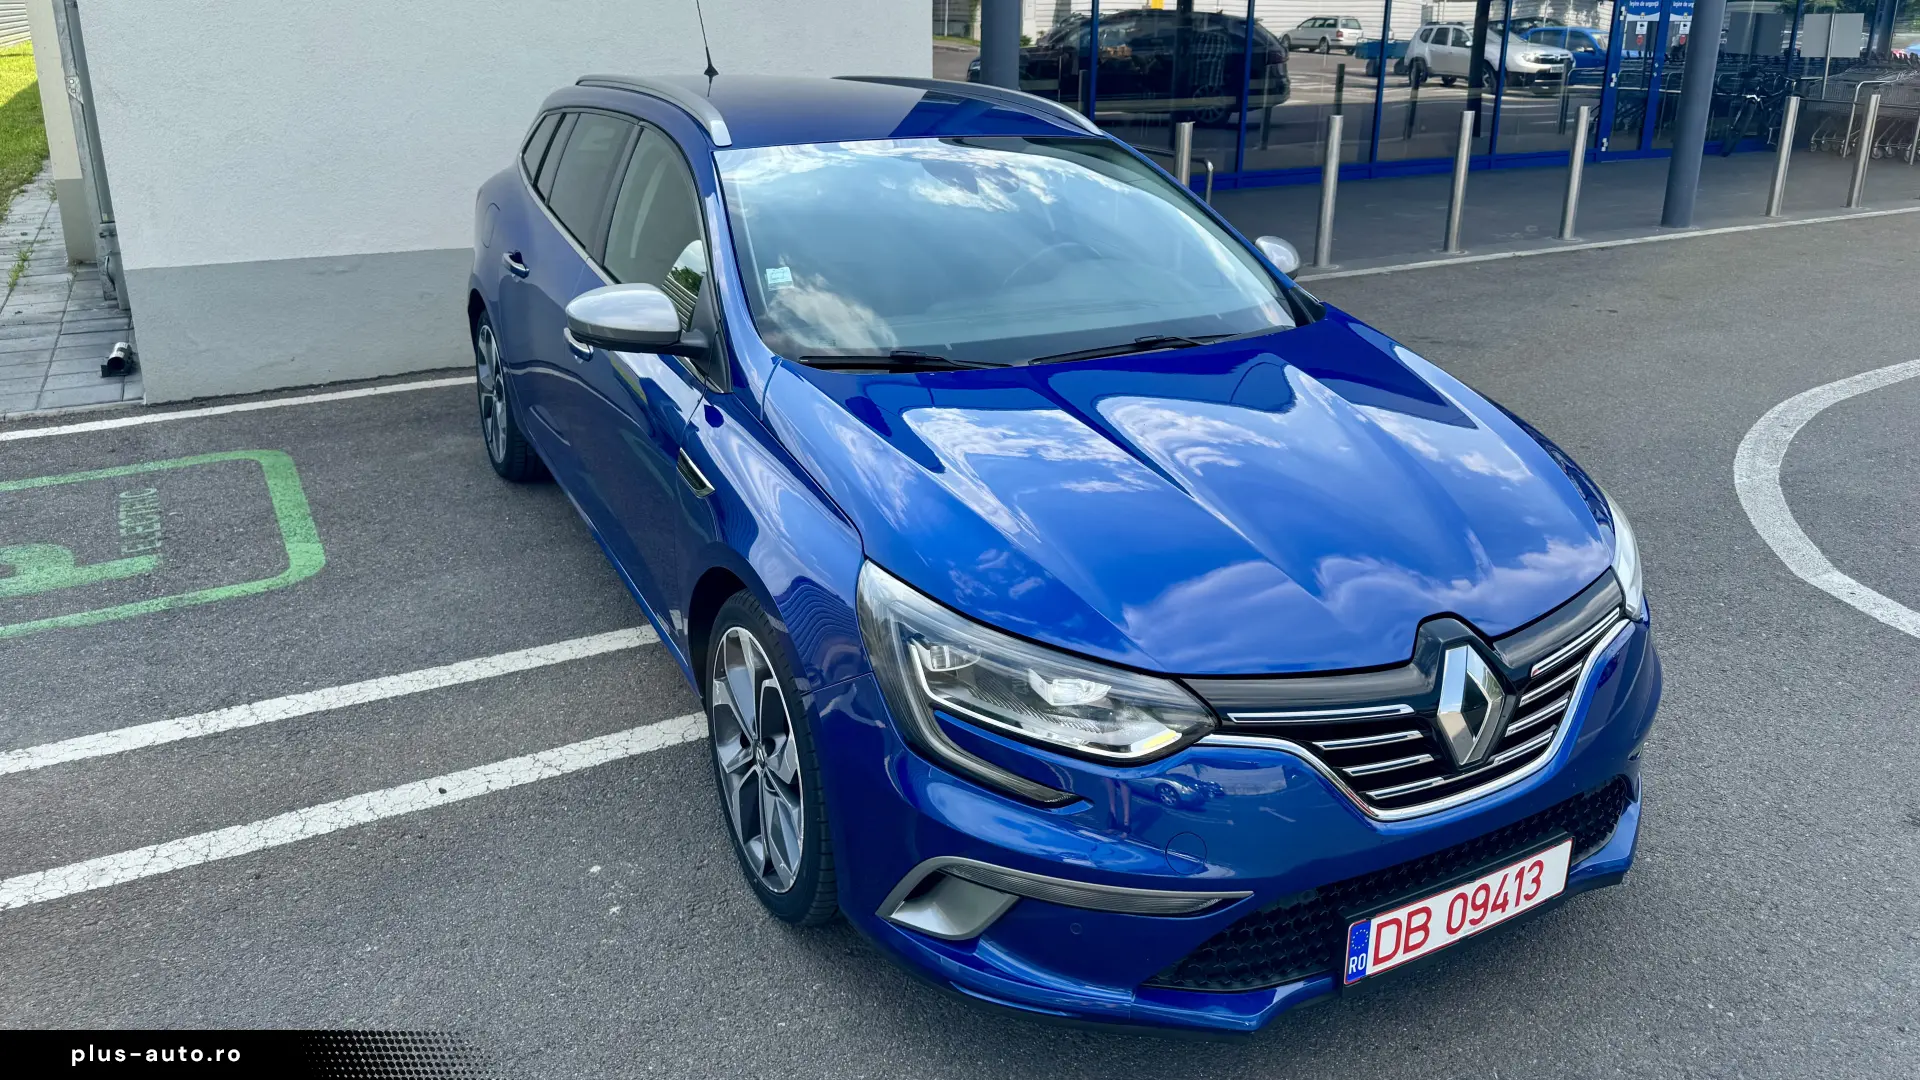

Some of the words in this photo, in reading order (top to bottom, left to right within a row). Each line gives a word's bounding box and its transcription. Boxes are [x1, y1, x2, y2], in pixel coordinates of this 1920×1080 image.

[1372, 905, 1433, 967] DB
[1445, 859, 1544, 936] 09413
[1348, 952, 1367, 975] RO
